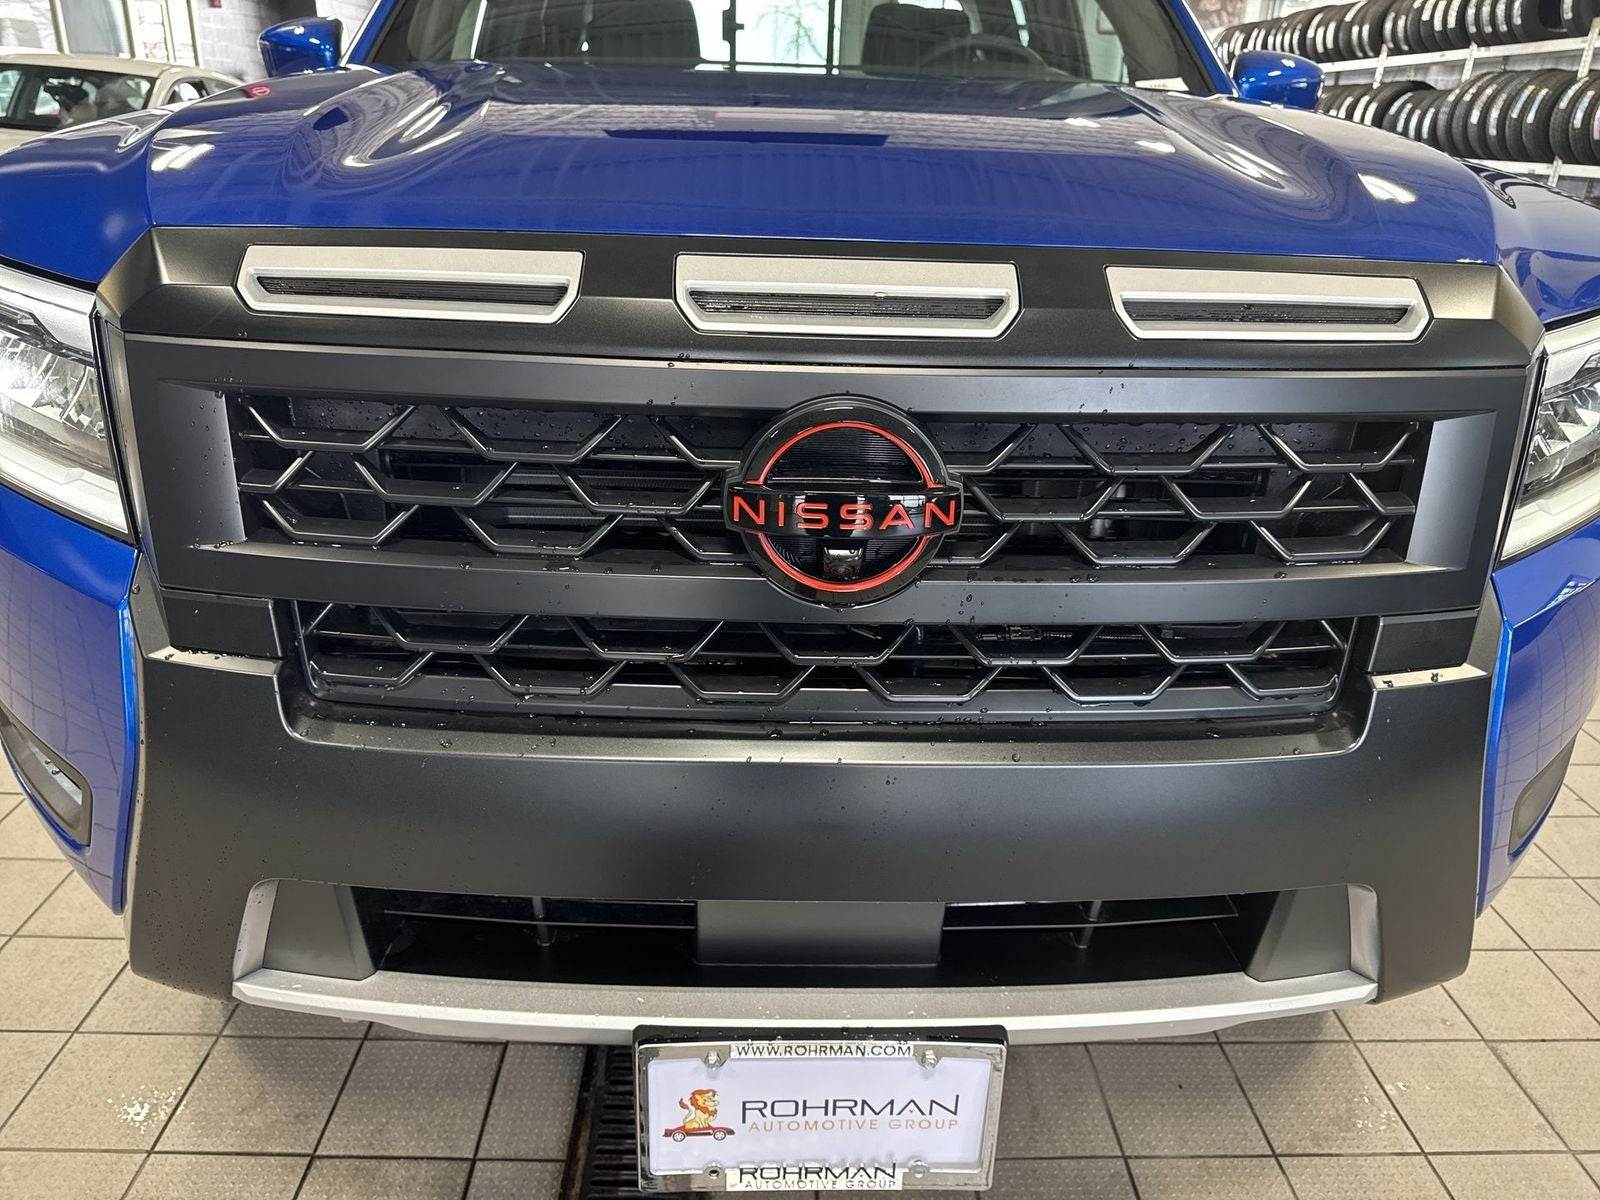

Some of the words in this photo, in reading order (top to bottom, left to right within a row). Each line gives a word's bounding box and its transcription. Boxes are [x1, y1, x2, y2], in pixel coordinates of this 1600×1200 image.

[733, 495, 956, 530] NISSAN
[736, 1045, 912, 1057] WWW.ROHRMAN.COM
[742, 1094, 960, 1124] ROHRMAN
[748, 1119, 878, 1132] AUTOMOTIVE
[888, 1118, 959, 1131] GROUP
[739, 1162, 896, 1183] ROHRMAN
[744, 1179, 837, 1190] AUTOMOTIVE
[845, 1179, 896, 1190] GROUP
